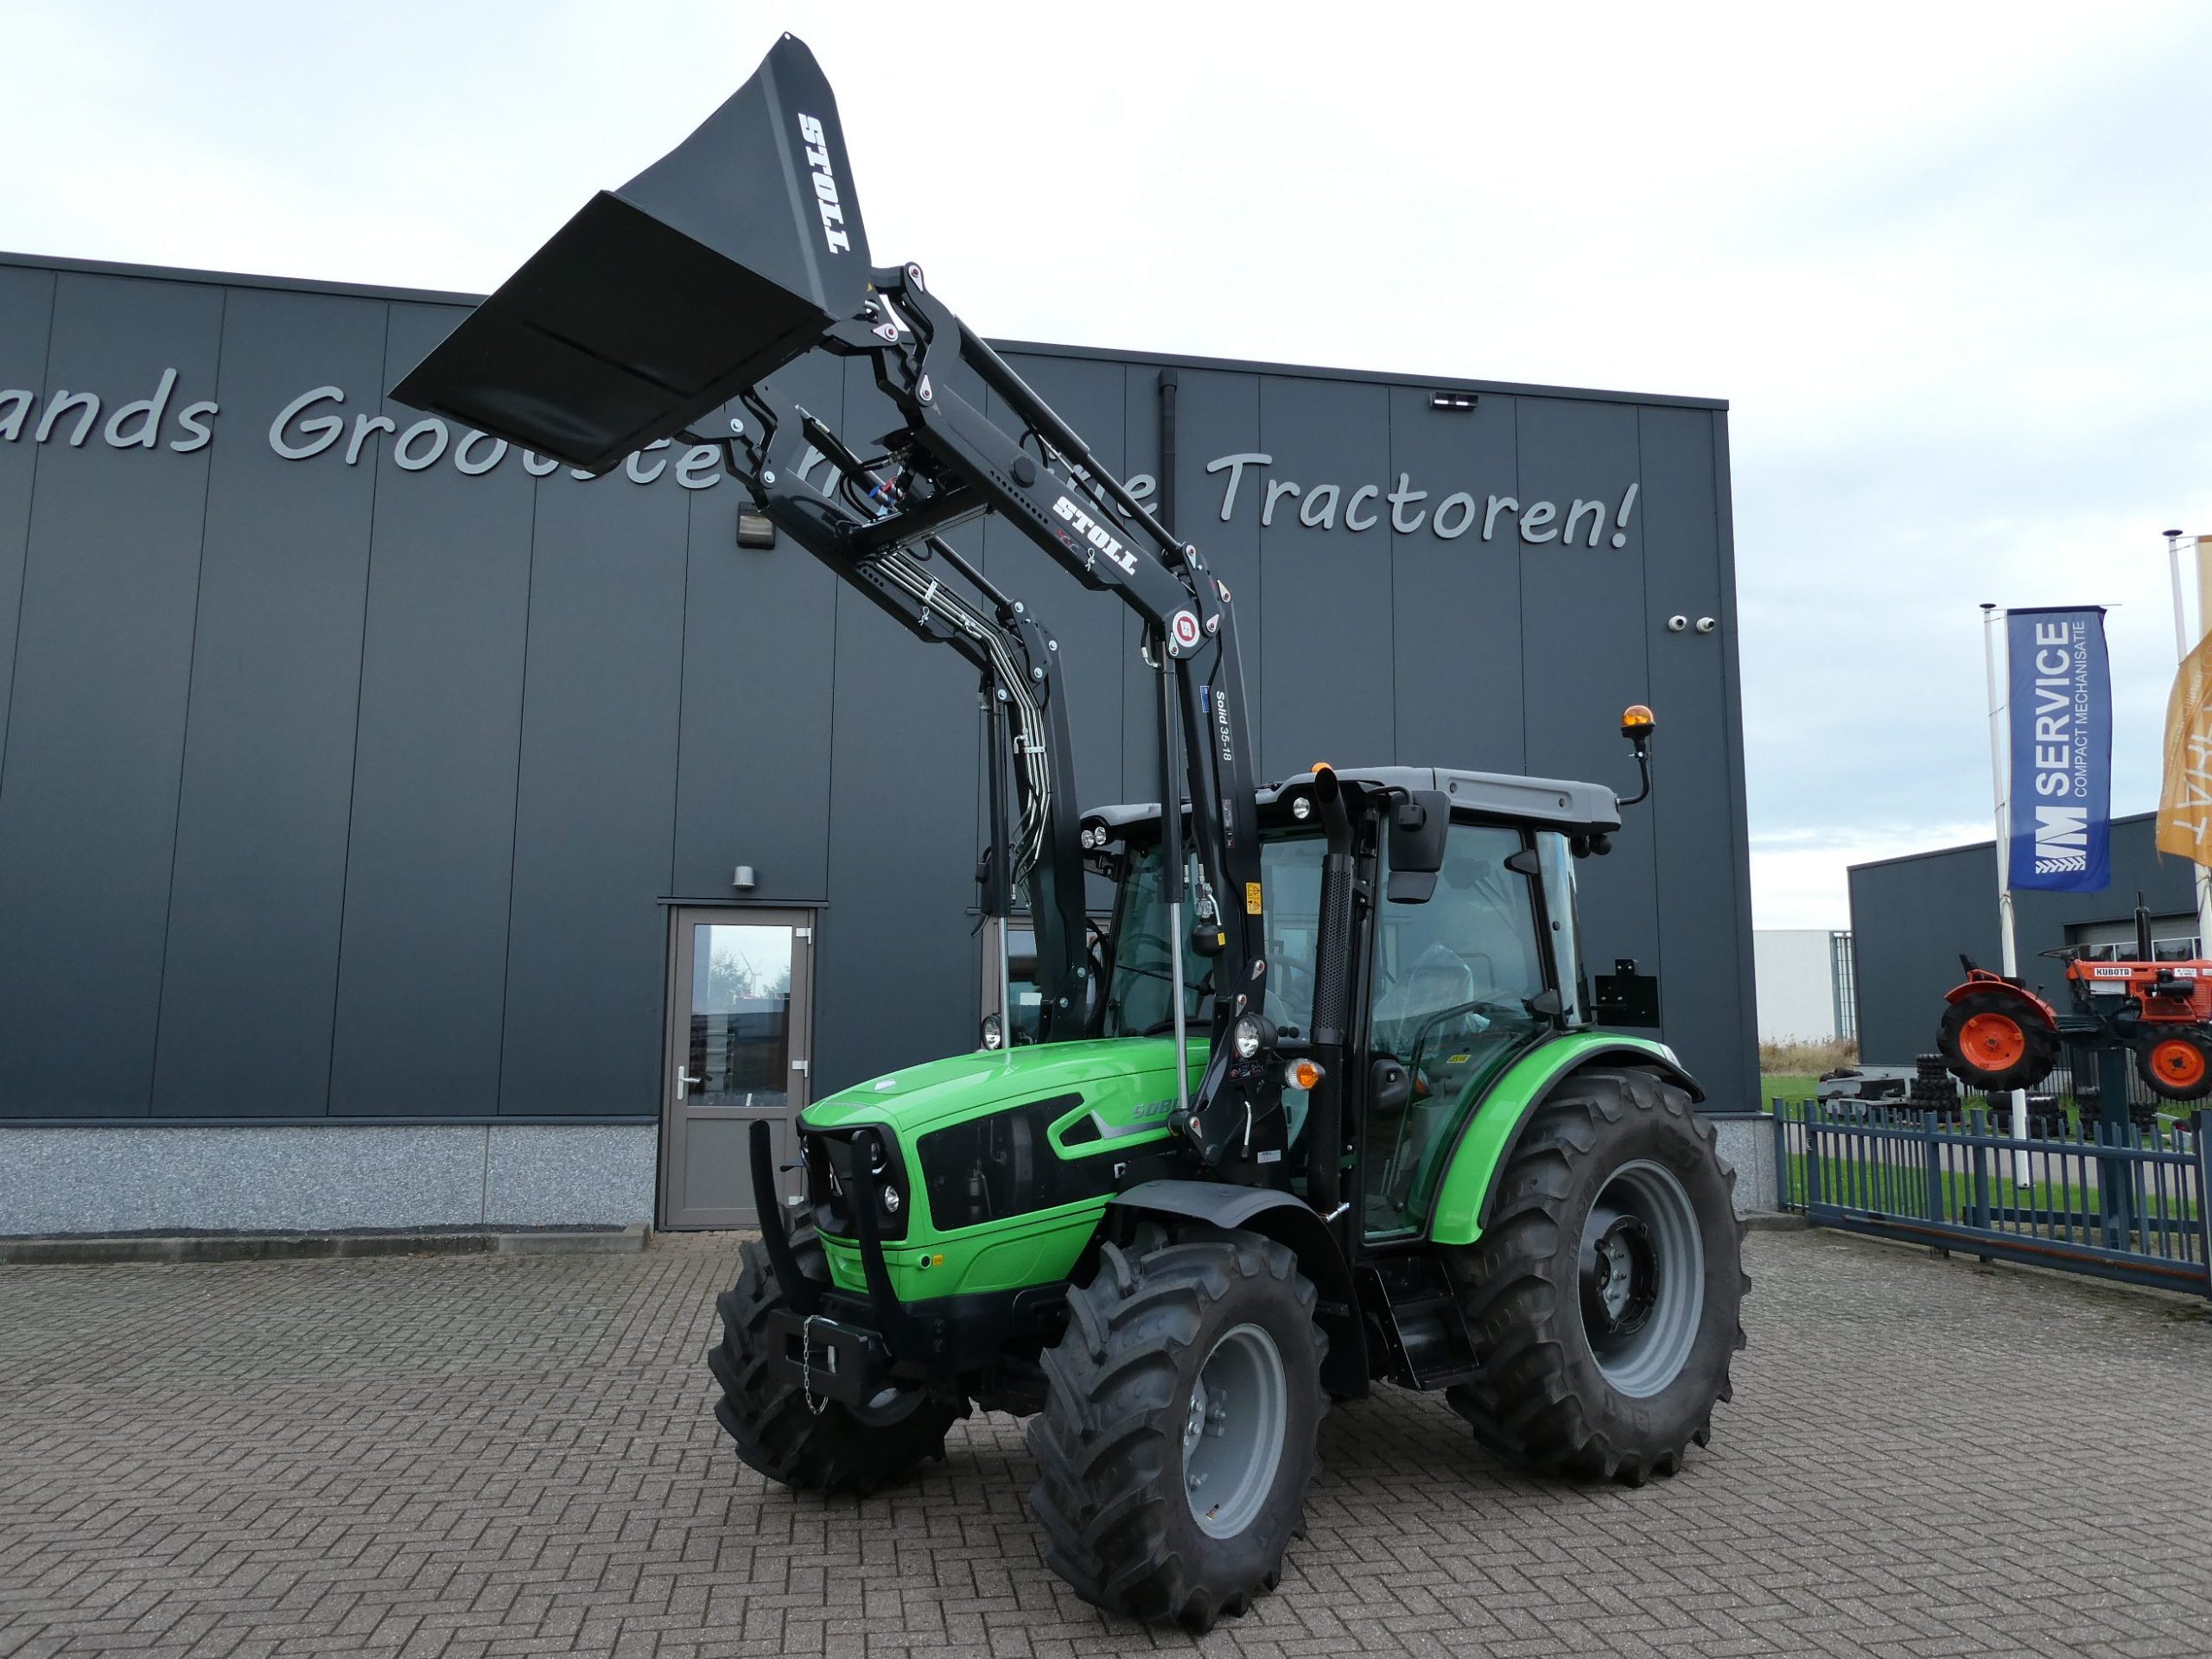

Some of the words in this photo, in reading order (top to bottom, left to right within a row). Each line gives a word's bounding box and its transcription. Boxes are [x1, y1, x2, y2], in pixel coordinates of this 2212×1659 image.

[798, 112, 851, 255] STOLL
[1052, 496, 1138, 576] STOLL
[1206, 453, 1639, 549] Tractoren!
[1217, 690, 1228, 725] Solid
[2035, 620, 2070, 798] SERVICE
[2073, 620, 2088, 726] MECHANISATIE
[1220, 727, 1232, 761] 35-18
[2074, 729, 2088, 798] COMPACT
